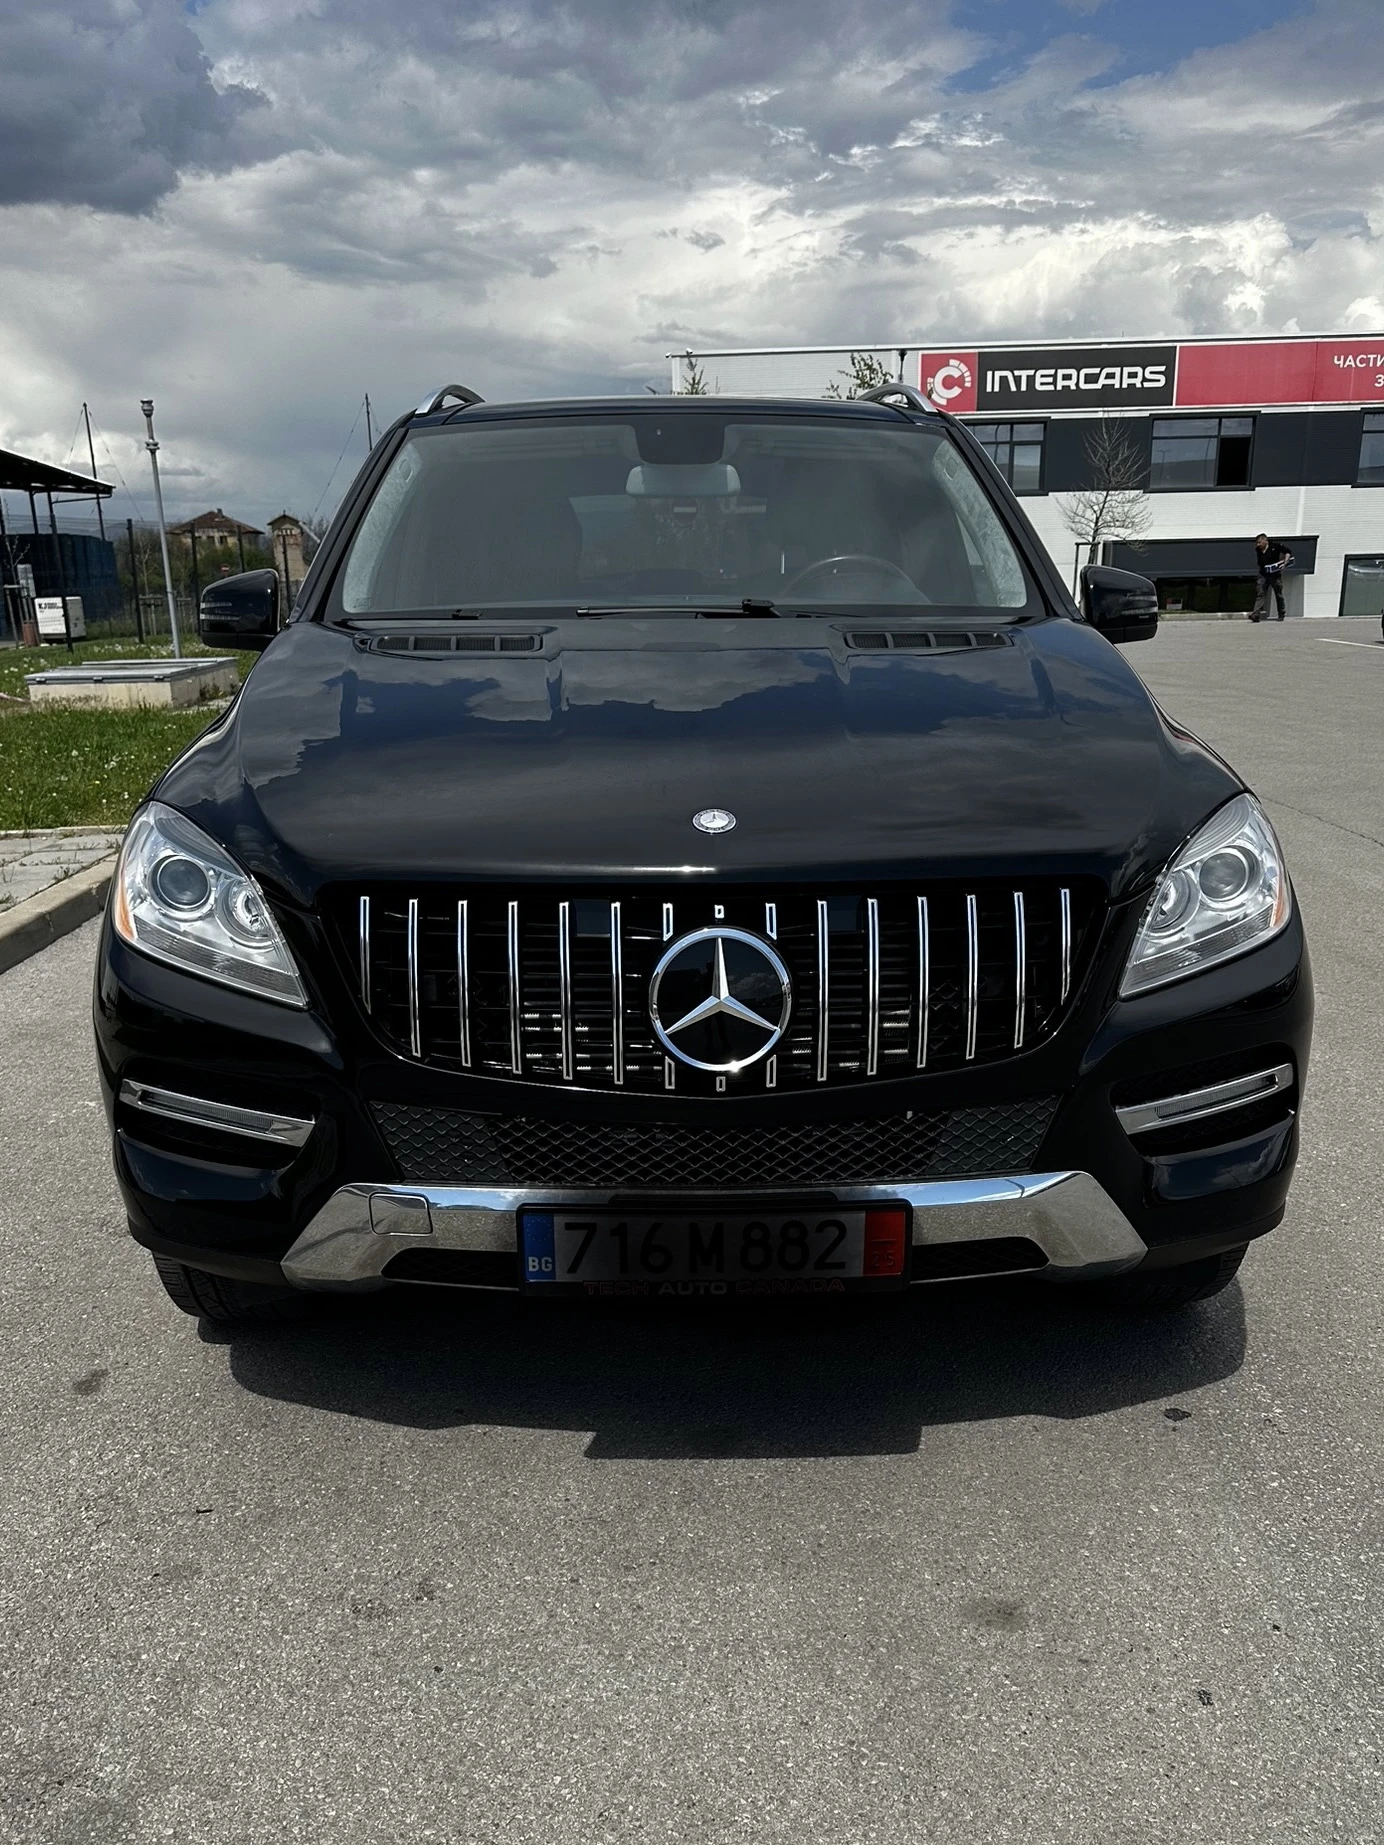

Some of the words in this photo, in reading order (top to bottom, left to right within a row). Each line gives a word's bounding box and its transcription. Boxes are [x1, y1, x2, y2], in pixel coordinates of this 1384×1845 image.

[986, 365, 1167, 393] INTERCARS
[563, 1221, 674, 1274] 716
[688, 1222, 724, 1273] M
[739, 1219, 847, 1272] 882
[528, 1256, 553, 1273] BG
[583, 1279, 649, 1297] TECH
[658, 1279, 728, 1296] AUTO
[735, 1277, 847, 1295] CANADA
